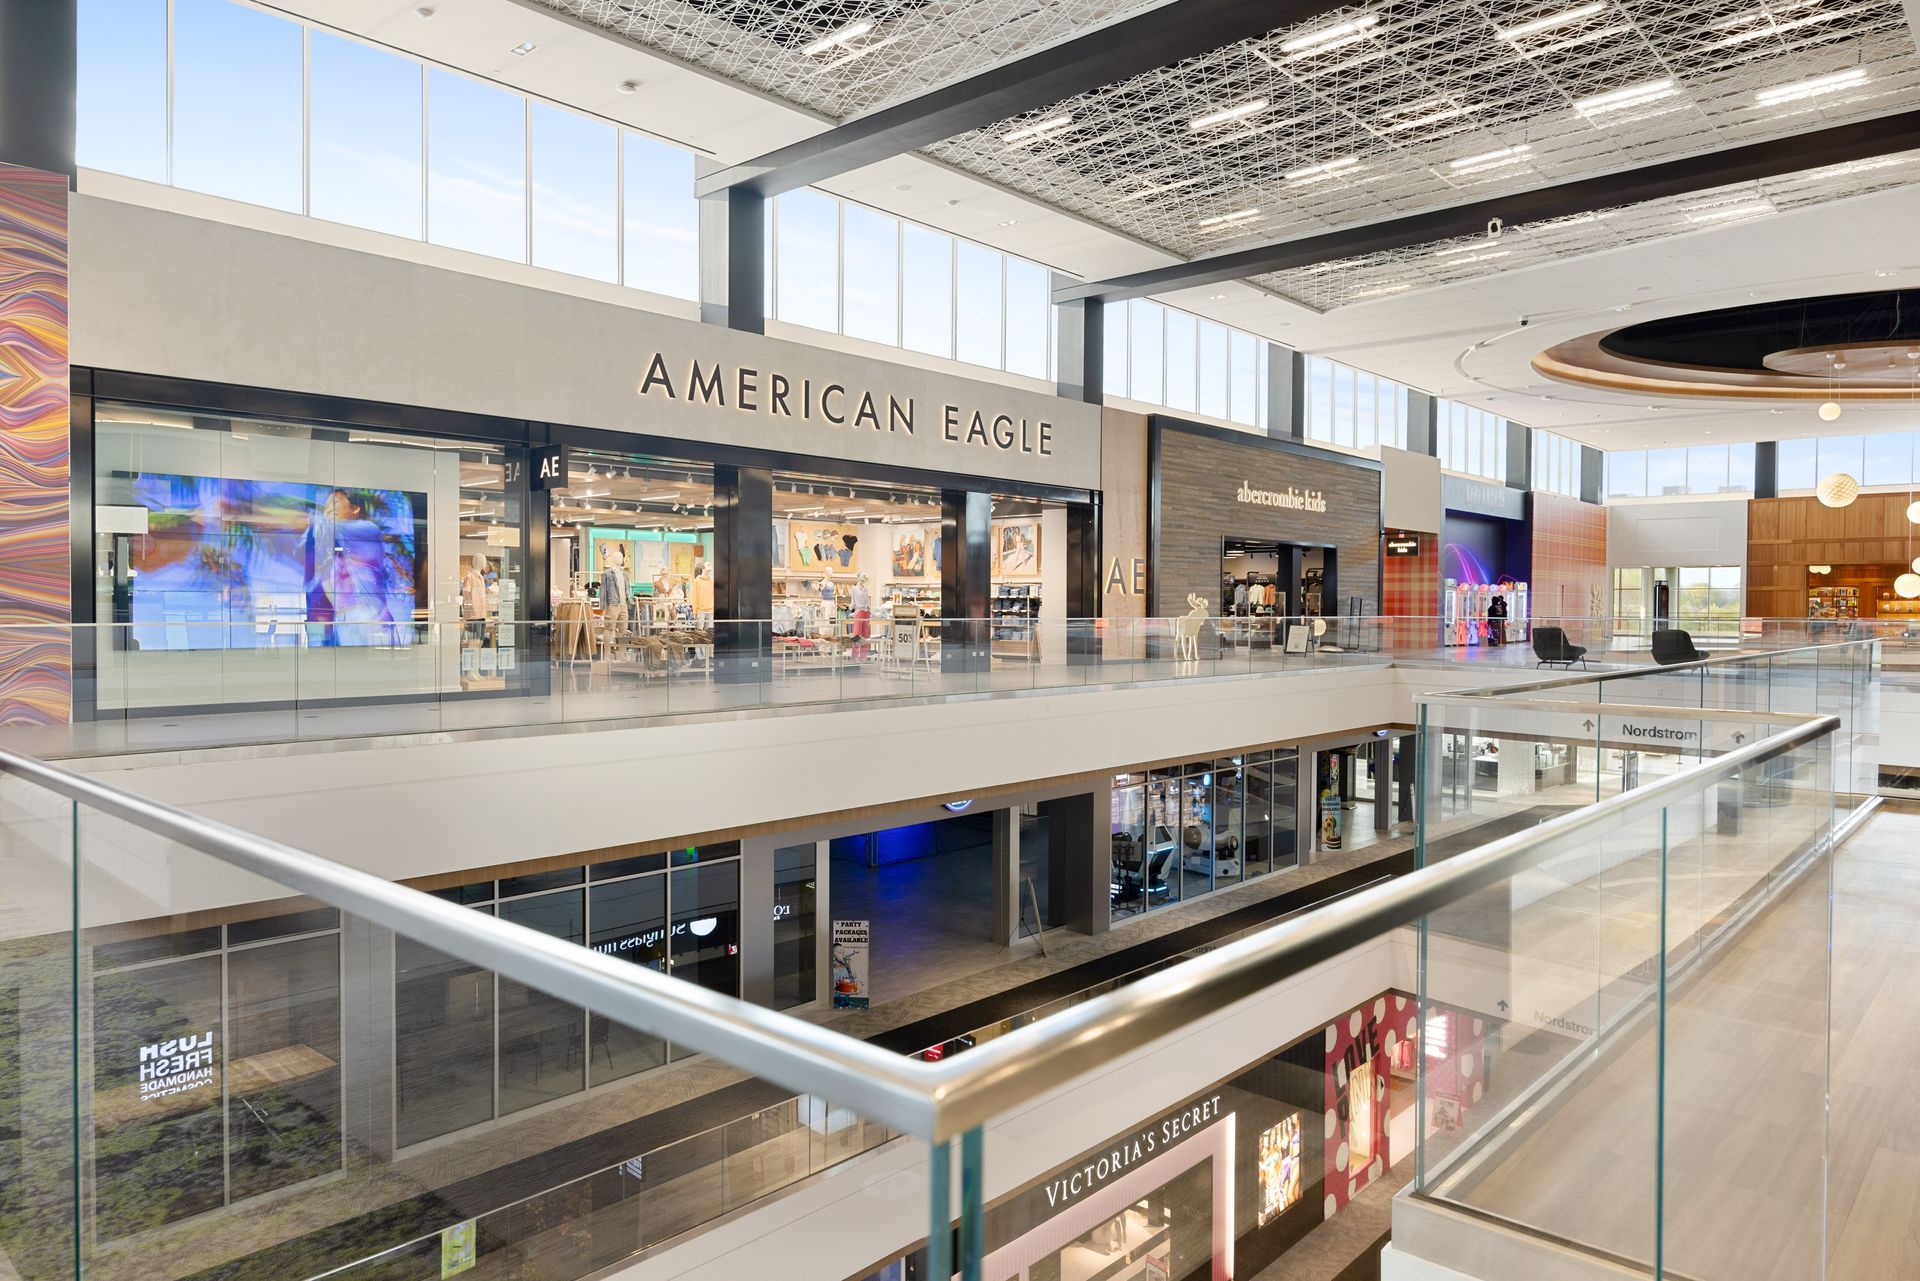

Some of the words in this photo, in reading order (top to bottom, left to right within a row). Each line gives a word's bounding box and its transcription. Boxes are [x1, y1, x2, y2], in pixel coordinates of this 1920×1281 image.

[639, 352, 914, 435] AMERICAN
[944, 404, 1052, 456] EAGLE
[540, 456, 560, 478] AE
[1237, 480, 1304, 510] abercrombie
[1304, 489, 1326, 512] kids
[1105, 557, 1145, 594] AE
[1622, 724, 1697, 740] Nordstrom
[1332, 1015, 1380, 1096] LOVE
[1045, 1131, 1155, 1208] VICTORIA'S
[1162, 1095, 1221, 1144] SECRET
